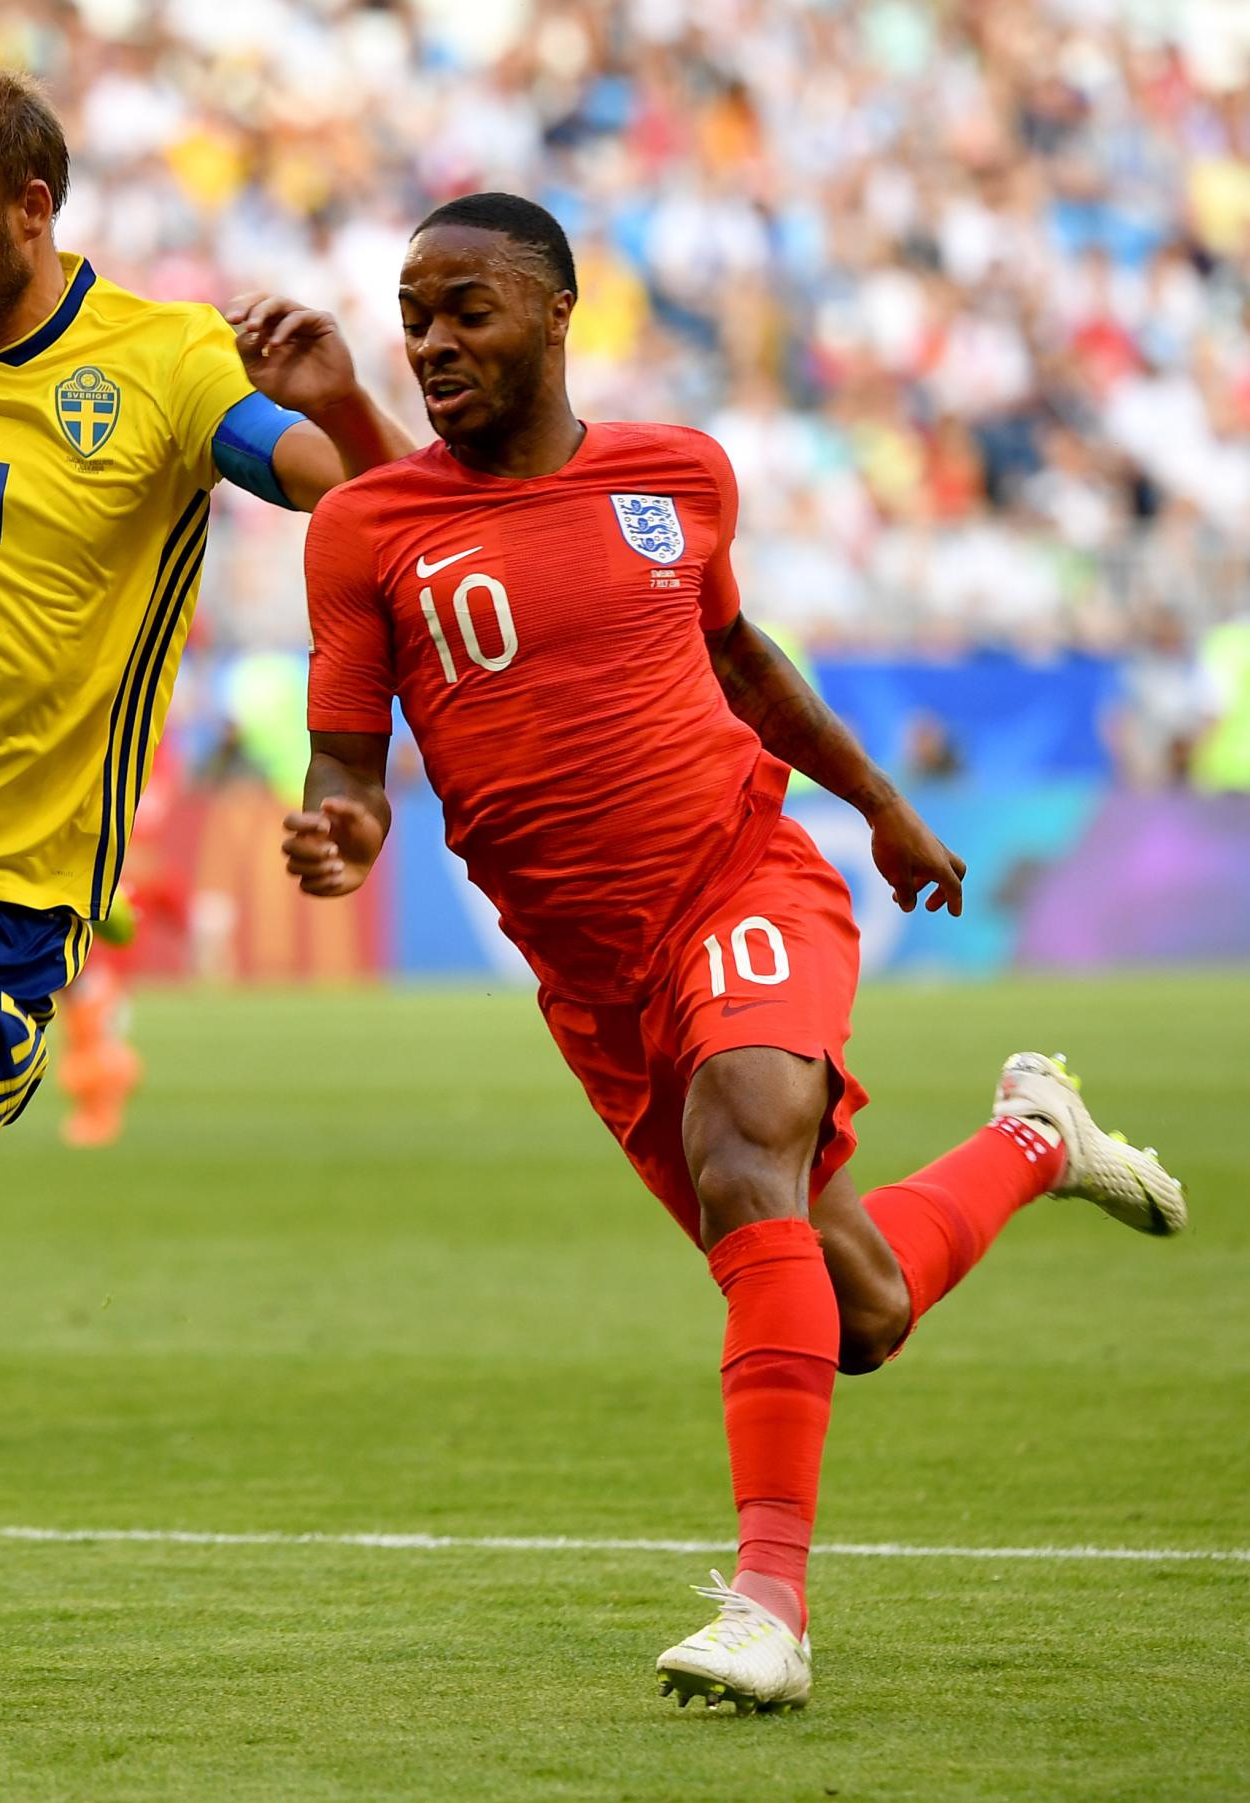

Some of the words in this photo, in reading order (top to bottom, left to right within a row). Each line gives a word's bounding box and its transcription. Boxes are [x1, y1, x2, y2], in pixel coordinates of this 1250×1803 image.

[67, 392, 108, 400] SVERIGE
[419, 573, 518, 683] 10
[703, 916, 790, 997] 10
